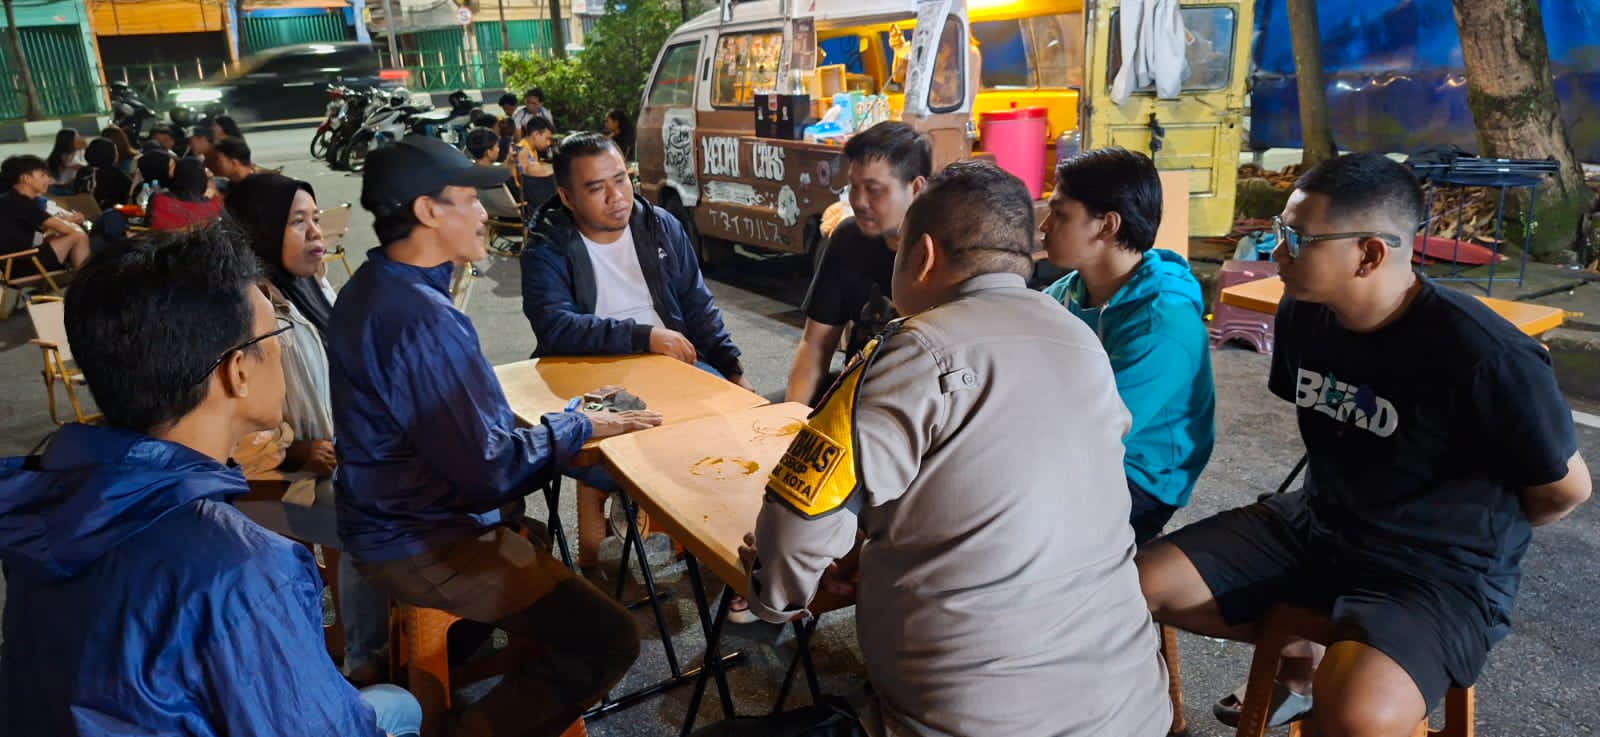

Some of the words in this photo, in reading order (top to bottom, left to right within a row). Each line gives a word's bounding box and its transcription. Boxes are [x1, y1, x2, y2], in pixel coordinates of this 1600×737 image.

[702, 136, 740, 178] KEDAI
[753, 143, 785, 182] CARS
[783, 471, 812, 498] KOTA
